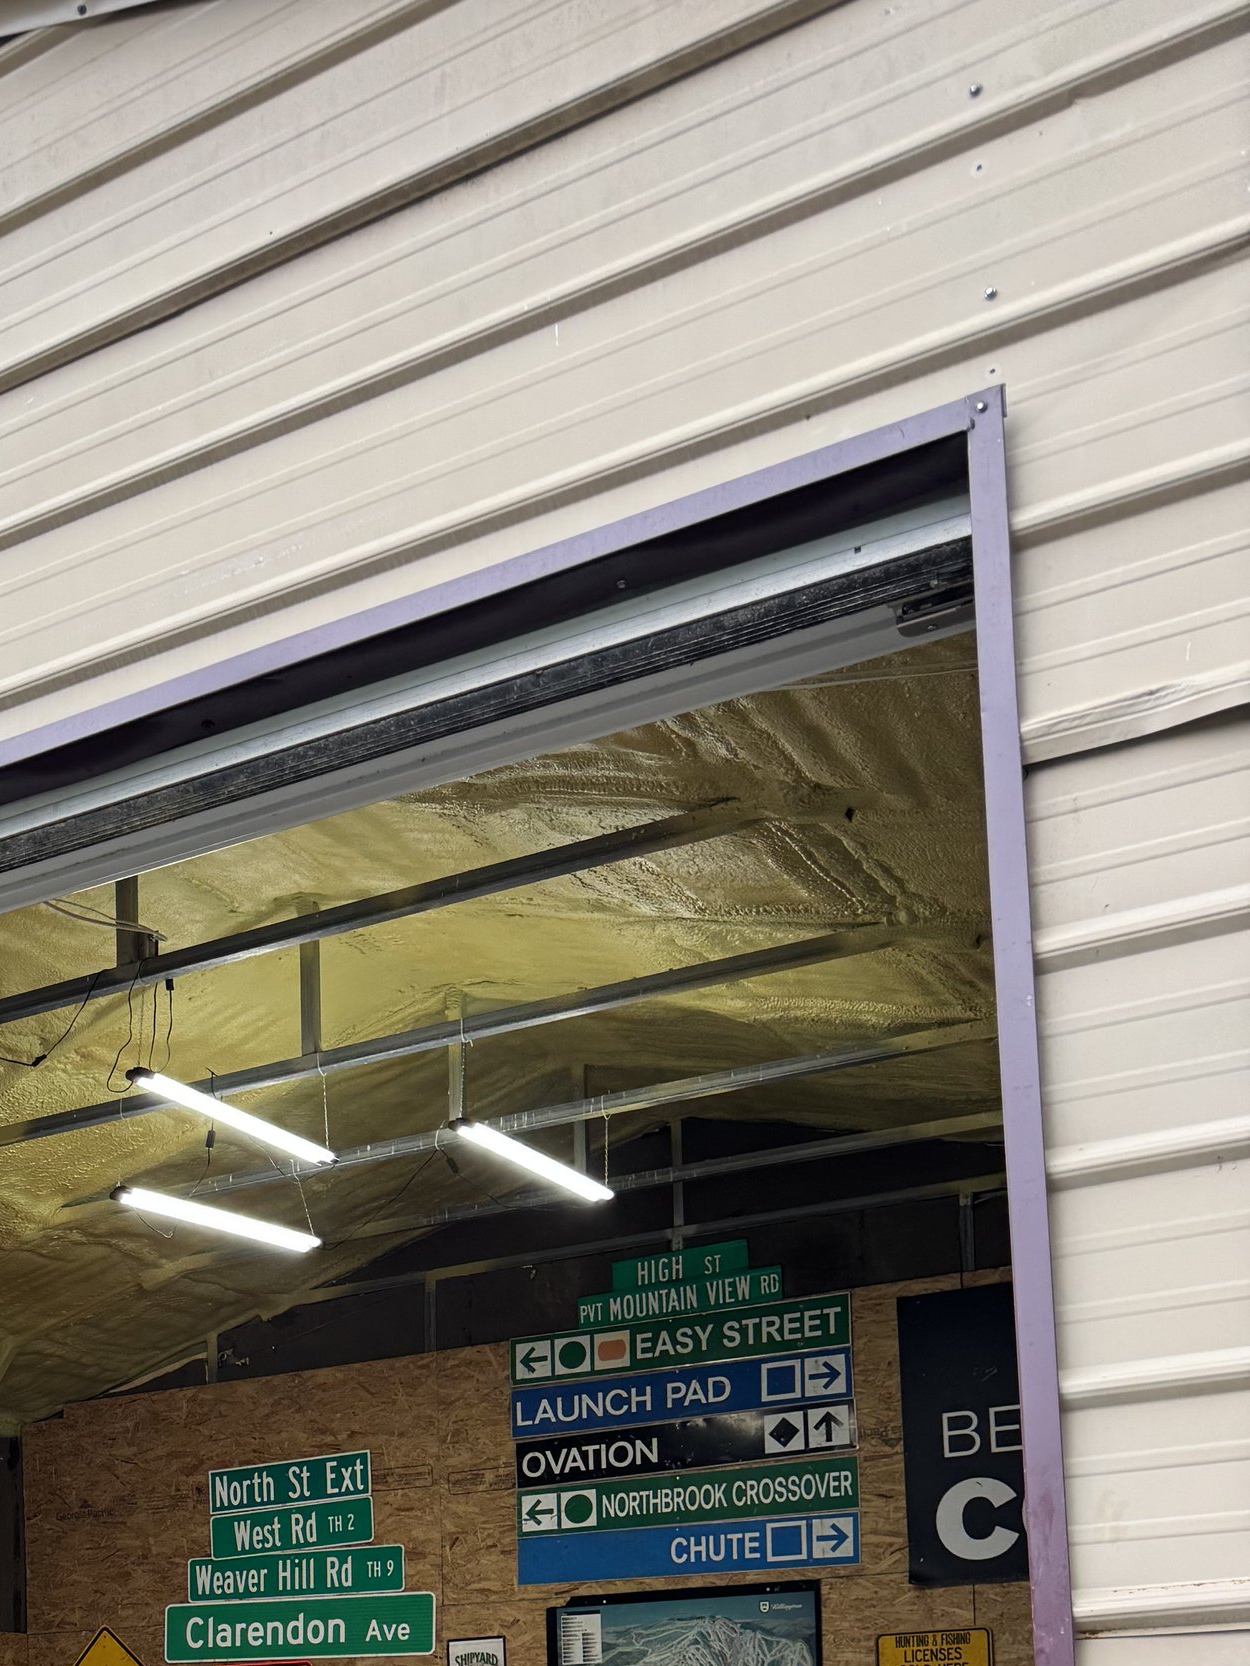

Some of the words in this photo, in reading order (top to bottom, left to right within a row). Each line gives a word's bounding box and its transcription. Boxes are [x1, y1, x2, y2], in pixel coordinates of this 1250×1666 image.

[637, 1255, 683, 1286] HIGH
[703, 1254, 722, 1275] ST
[580, 1303, 603, 1325] PVT
[609, 1284, 699, 1322] MOUNTAIN
[706, 1275, 751, 1306] VIEW
[760, 1273, 780, 1295] RD
[636, 1324, 713, 1360] EASY
[722, 1306, 842, 1348] STREET
[515, 1385, 652, 1427] LAUNCH
[666, 1376, 732, 1408] PAD
[521, 1437, 659, 1478] OVATION
[214, 1470, 275, 1508] North
[288, 1465, 311, 1499] St
[325, 1457, 365, 1495] Ext
[601, 1483, 727, 1519] NORTHBROOK
[732, 1470, 853, 1507] CROSSOVER
[233, 1515, 282, 1551] West
[290, 1510, 318, 1545] Rd
[328, 1515, 343, 1533] TH
[347, 1513, 355, 1530] 2
[935, 1476, 1027, 1561] C
[670, 1531, 761, 1564] CHUTE
[194, 1564, 268, 1596] Weaver
[277, 1557, 315, 1591] Hill
[326, 1555, 353, 1588] Rd
[366, 1560, 382, 1578] TH
[387, 1560, 395, 1576] 9
[185, 1612, 346, 1649] Clarendon
[365, 1618, 411, 1642] Ave
[895, 1634, 930, 1648] HUNTING
[932, 1633, 938, 1647] &
[940, 1631, 971, 1646] FISHING
[904, 1647, 963, 1663] LICENSES
